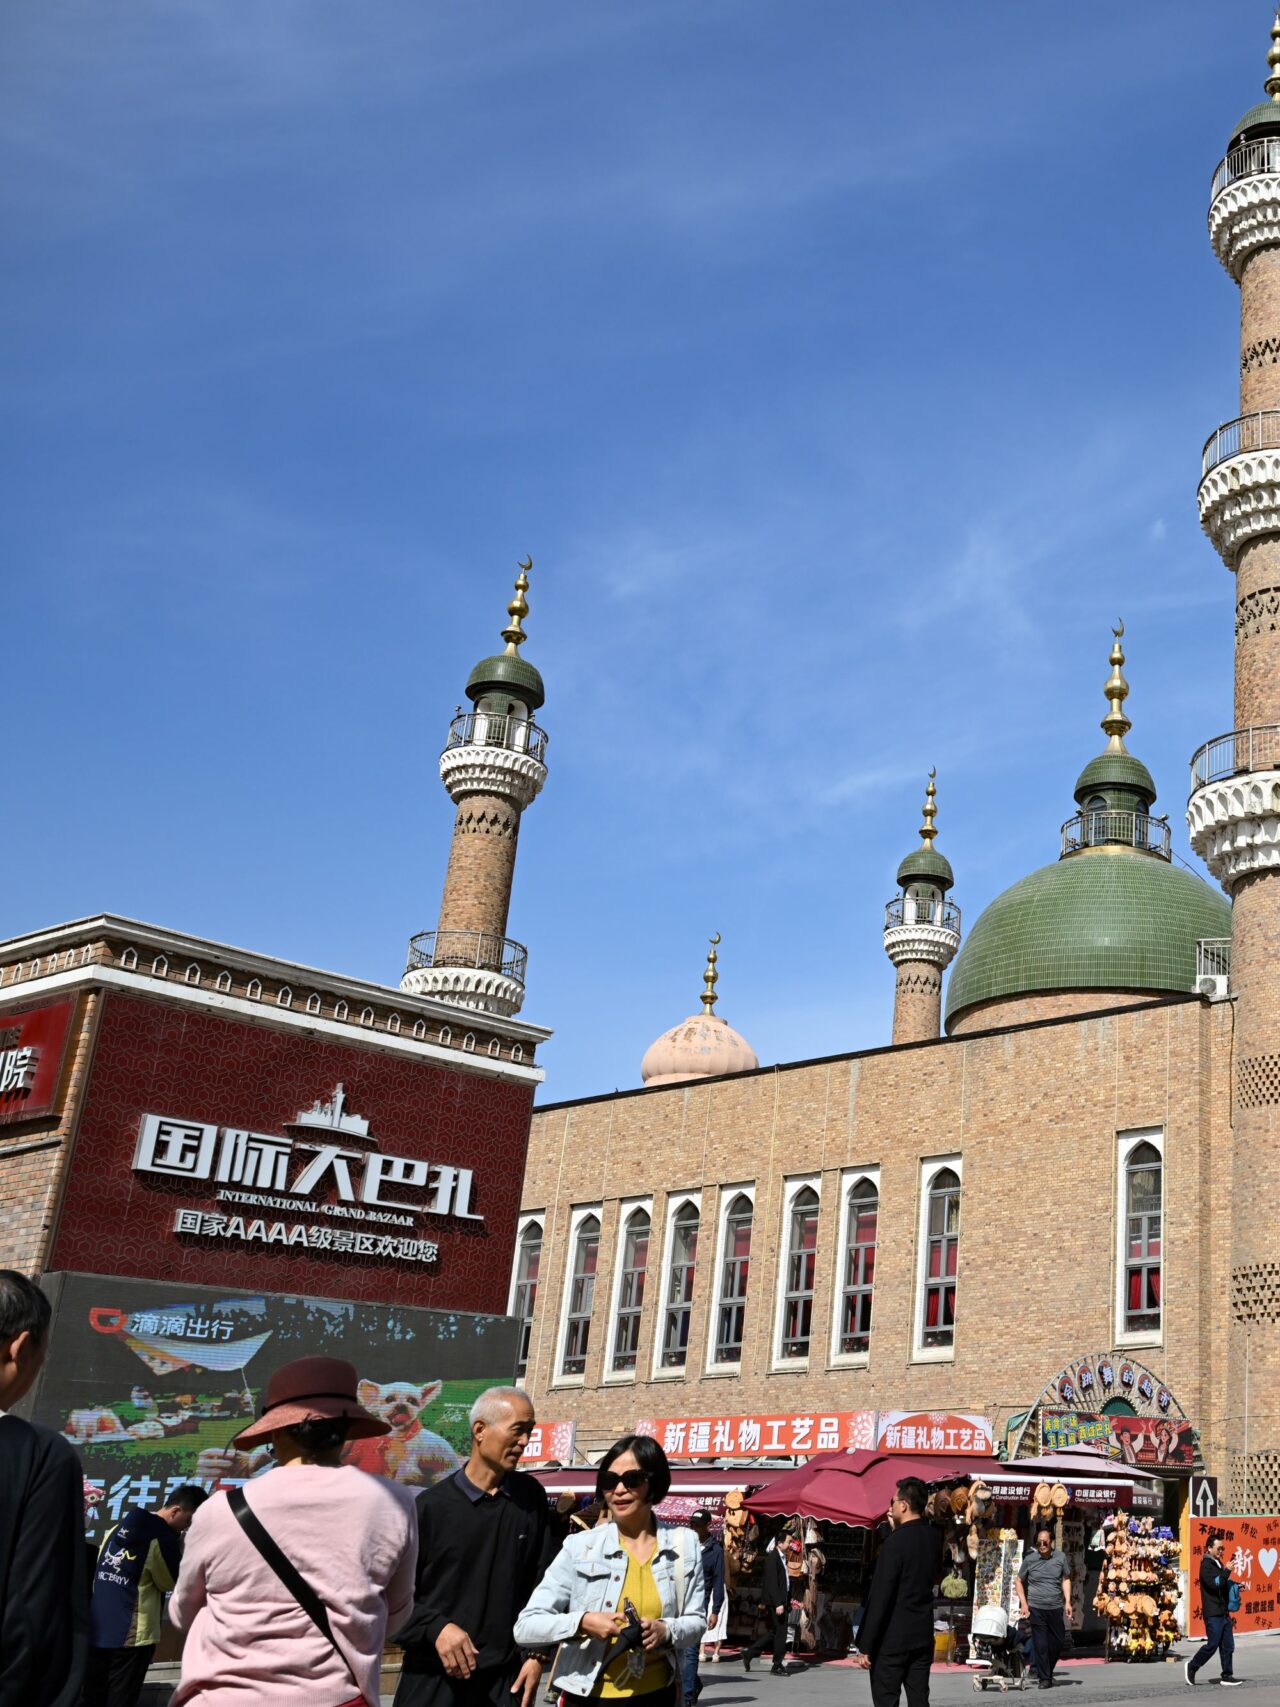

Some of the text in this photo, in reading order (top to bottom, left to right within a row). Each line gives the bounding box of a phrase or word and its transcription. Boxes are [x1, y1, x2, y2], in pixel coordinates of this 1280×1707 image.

[0, 1046, 32, 1091] 院
[131, 1113, 484, 1220] 国际大巴扎
[216, 1189, 414, 1227] INTERNATIONAL GRAND BAZAAR
[173, 1208, 439, 1263] 国家AAAA级景区欢迎您
[131, 1313, 235, 1340] 滴滴出行
[663, 1417, 840, 1455] 新疆礼物工艺品
[885, 1424, 986, 1451] 新疆礼物工艺品
[1075, 1489, 1116, 1498] 中国建设银行
[1233, 1546, 1254, 1578] 新
